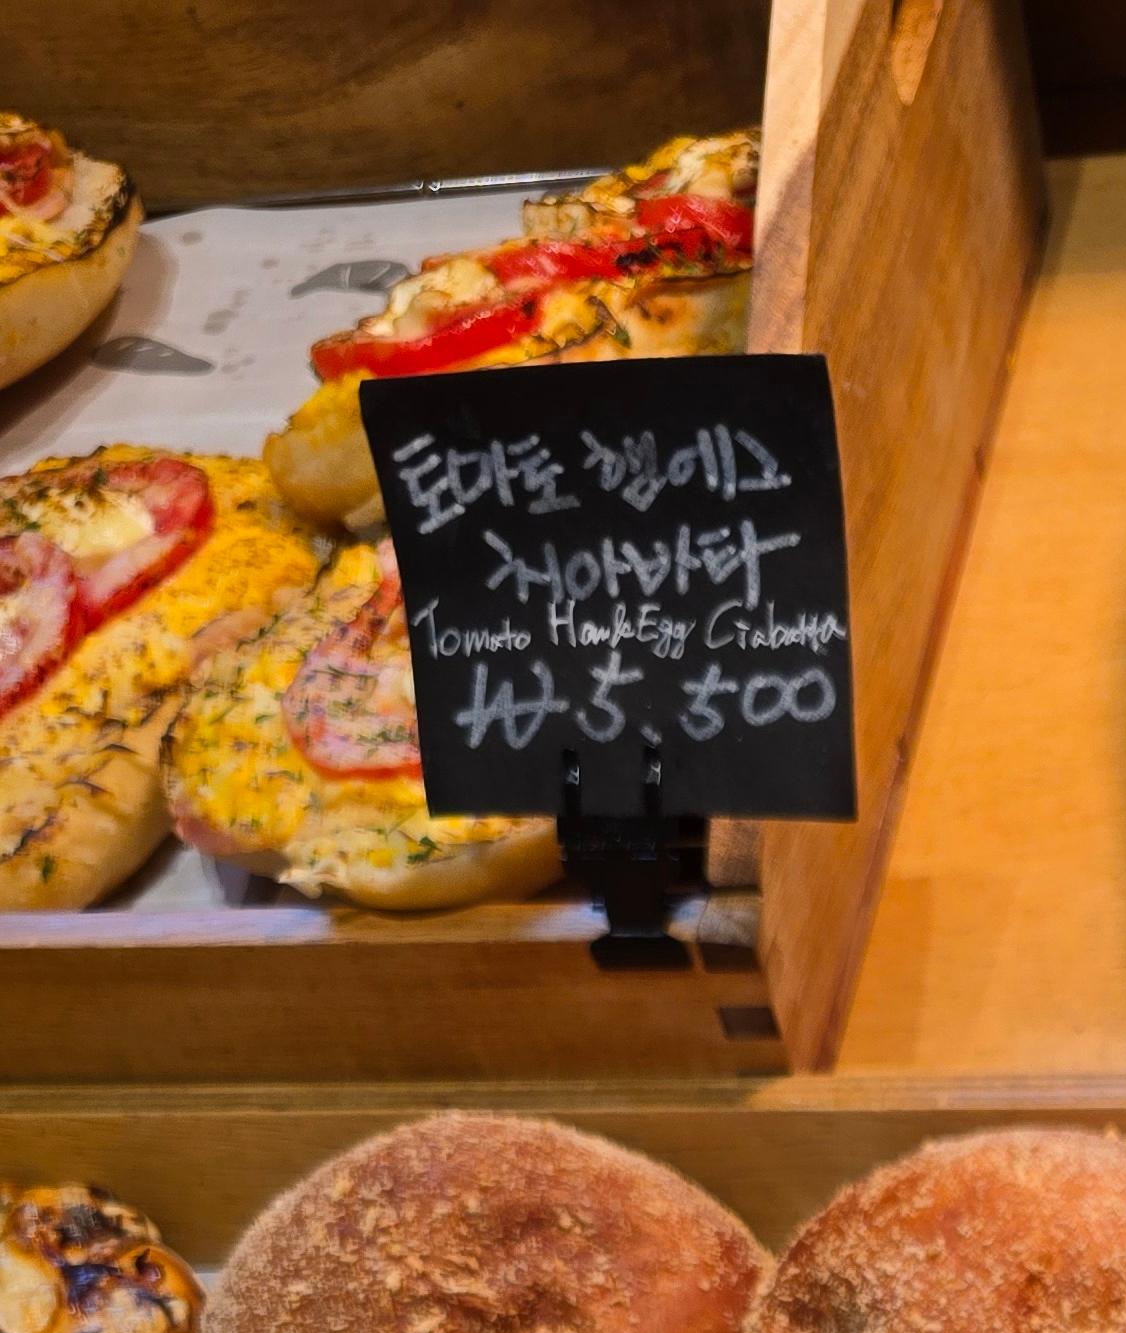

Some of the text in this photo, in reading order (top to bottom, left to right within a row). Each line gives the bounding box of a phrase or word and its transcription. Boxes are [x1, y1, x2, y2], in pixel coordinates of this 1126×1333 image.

[394, 424, 792, 534] 토마토 햄에그
[484, 519, 800, 610] 치아바타
[411, 598, 531, 660] Tomato
